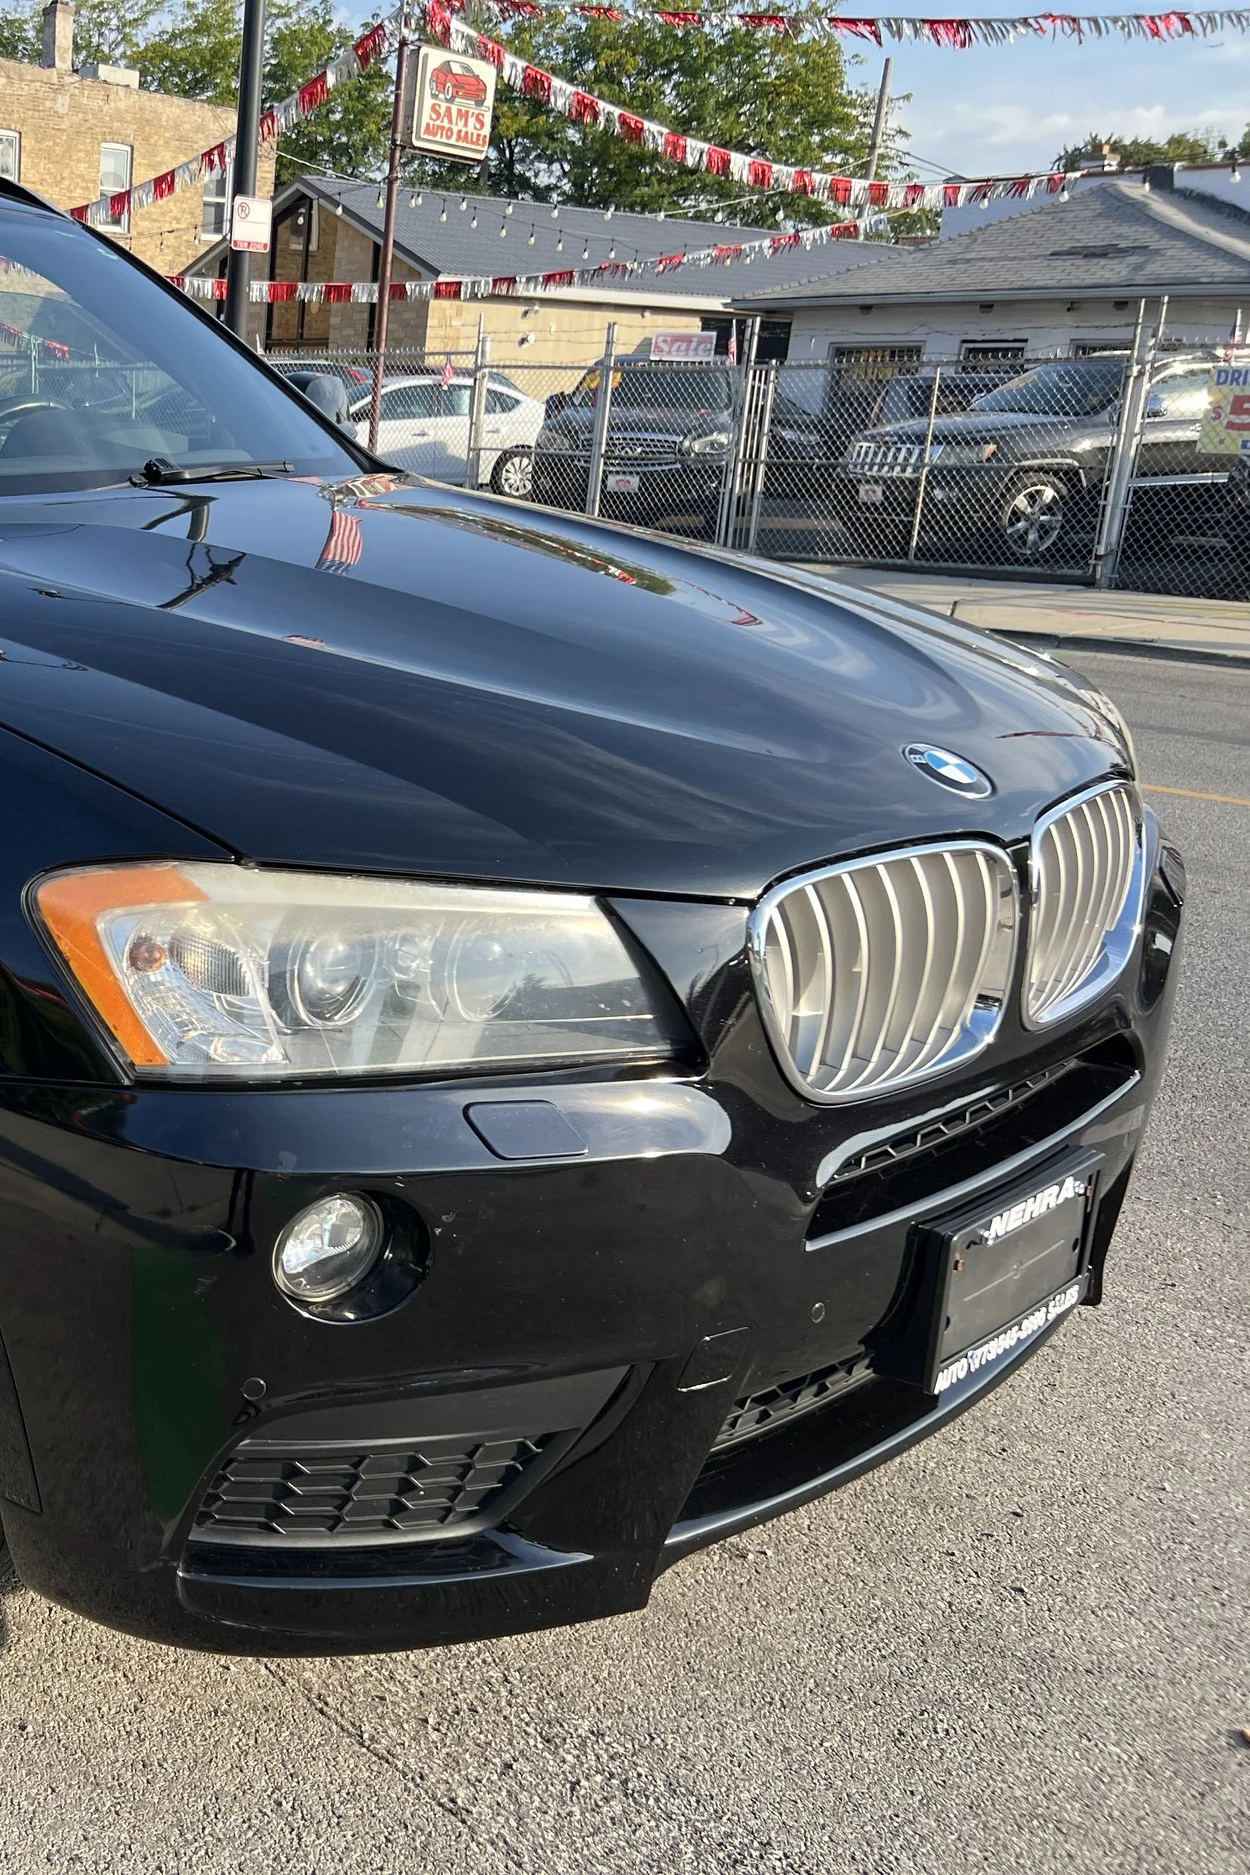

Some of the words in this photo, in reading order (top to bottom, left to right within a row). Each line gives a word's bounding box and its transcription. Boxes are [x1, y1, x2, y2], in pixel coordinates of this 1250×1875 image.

[429, 102, 485, 131] SAM'S
[423, 122, 454, 141] AUTO
[455, 129, 488, 148] SALES
[654, 336, 712, 356] Sale
[989, 1175, 1075, 1238] NEHRA
[934, 1357, 968, 1395] AUTO
